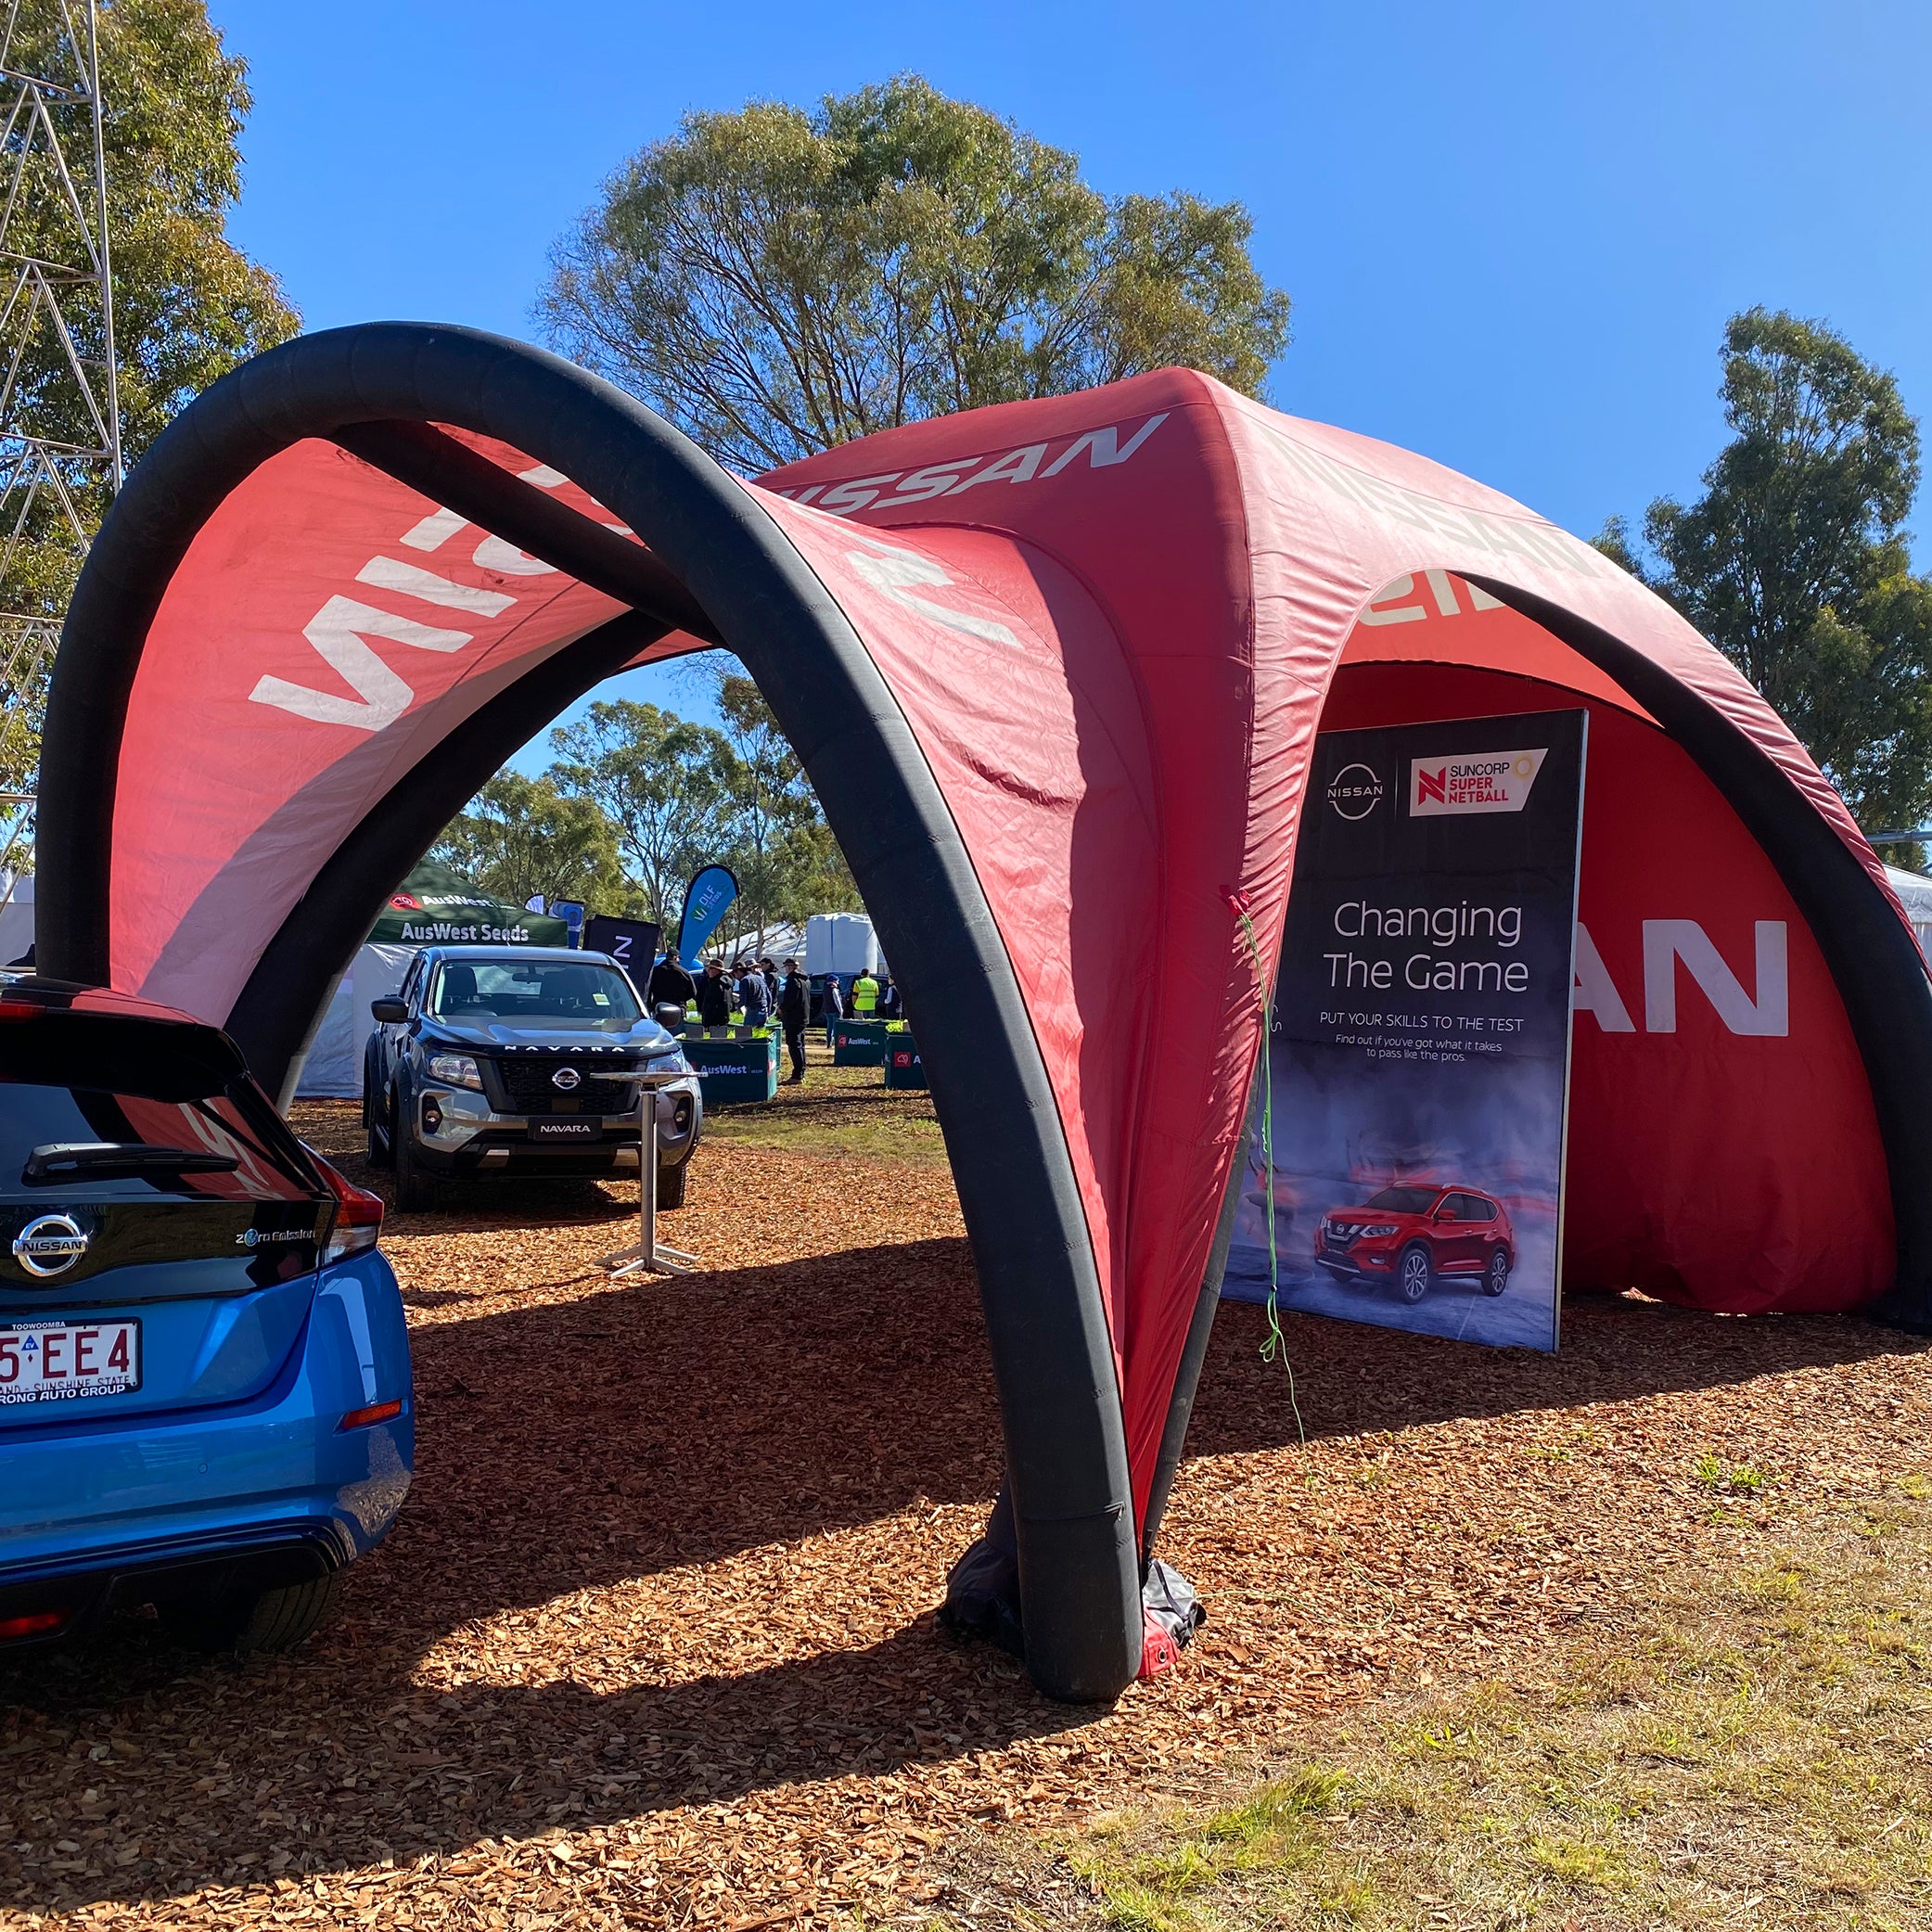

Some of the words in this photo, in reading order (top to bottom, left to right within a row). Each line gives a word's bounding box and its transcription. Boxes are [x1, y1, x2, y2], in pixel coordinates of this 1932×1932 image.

[1450, 761, 1510, 777] SUNCORP
[1449, 776, 1493, 791] SUPER
[1327, 785, 1384, 799] NISSAN
[1448, 788, 1509, 804] NETBALL
[421, 894, 494, 908] AusWest
[401, 922, 477, 940] AusWest
[480, 924, 530, 941] Seeds
[1333, 900, 1522, 948] Changing
[1323, 952, 1393, 990] The
[1404, 953, 1529, 992] Game
[1320, 1011, 1345, 1025] PUT
[1348, 1012, 1382, 1027] YOUR
[1386, 1014, 1428, 1029] SKILLS
[1432, 1016, 1452, 1030] TO
[1457, 1017, 1484, 1030] THE
[1488, 1017, 1525, 1032] TEST
[1335, 1033, 1355, 1044] Find
[1357, 1035, 1373, 1045] out
[1375, 1035, 1382, 1046] if
[1383, 1037, 1414, 1050] you've
[1414, 1038, 1433, 1050] got
[1435, 1039, 1462, 1051] what
[1465, 1040, 1473, 1051] it
[1475, 1041, 1503, 1053] takes
[1366, 1047, 1376, 1058] to
[1378, 1050, 1402, 1061] pass
[1403, 1049, 1417, 1060] like
[1420, 1050, 1439, 1061] the
[1440, 1052, 1466, 1064] pros.
[700, 1065, 748, 1075] AusWest
[540, 1124, 591, 1133] NAVARA
[21, 1240, 83, 1253] NISSAN
[12, 1321, 67, 1331] TOOWOOMBA
[97, 1375, 130, 1386] STATE
[40, 1388, 77, 1401] AUTO
[80, 1384, 126, 1397] GROUP
